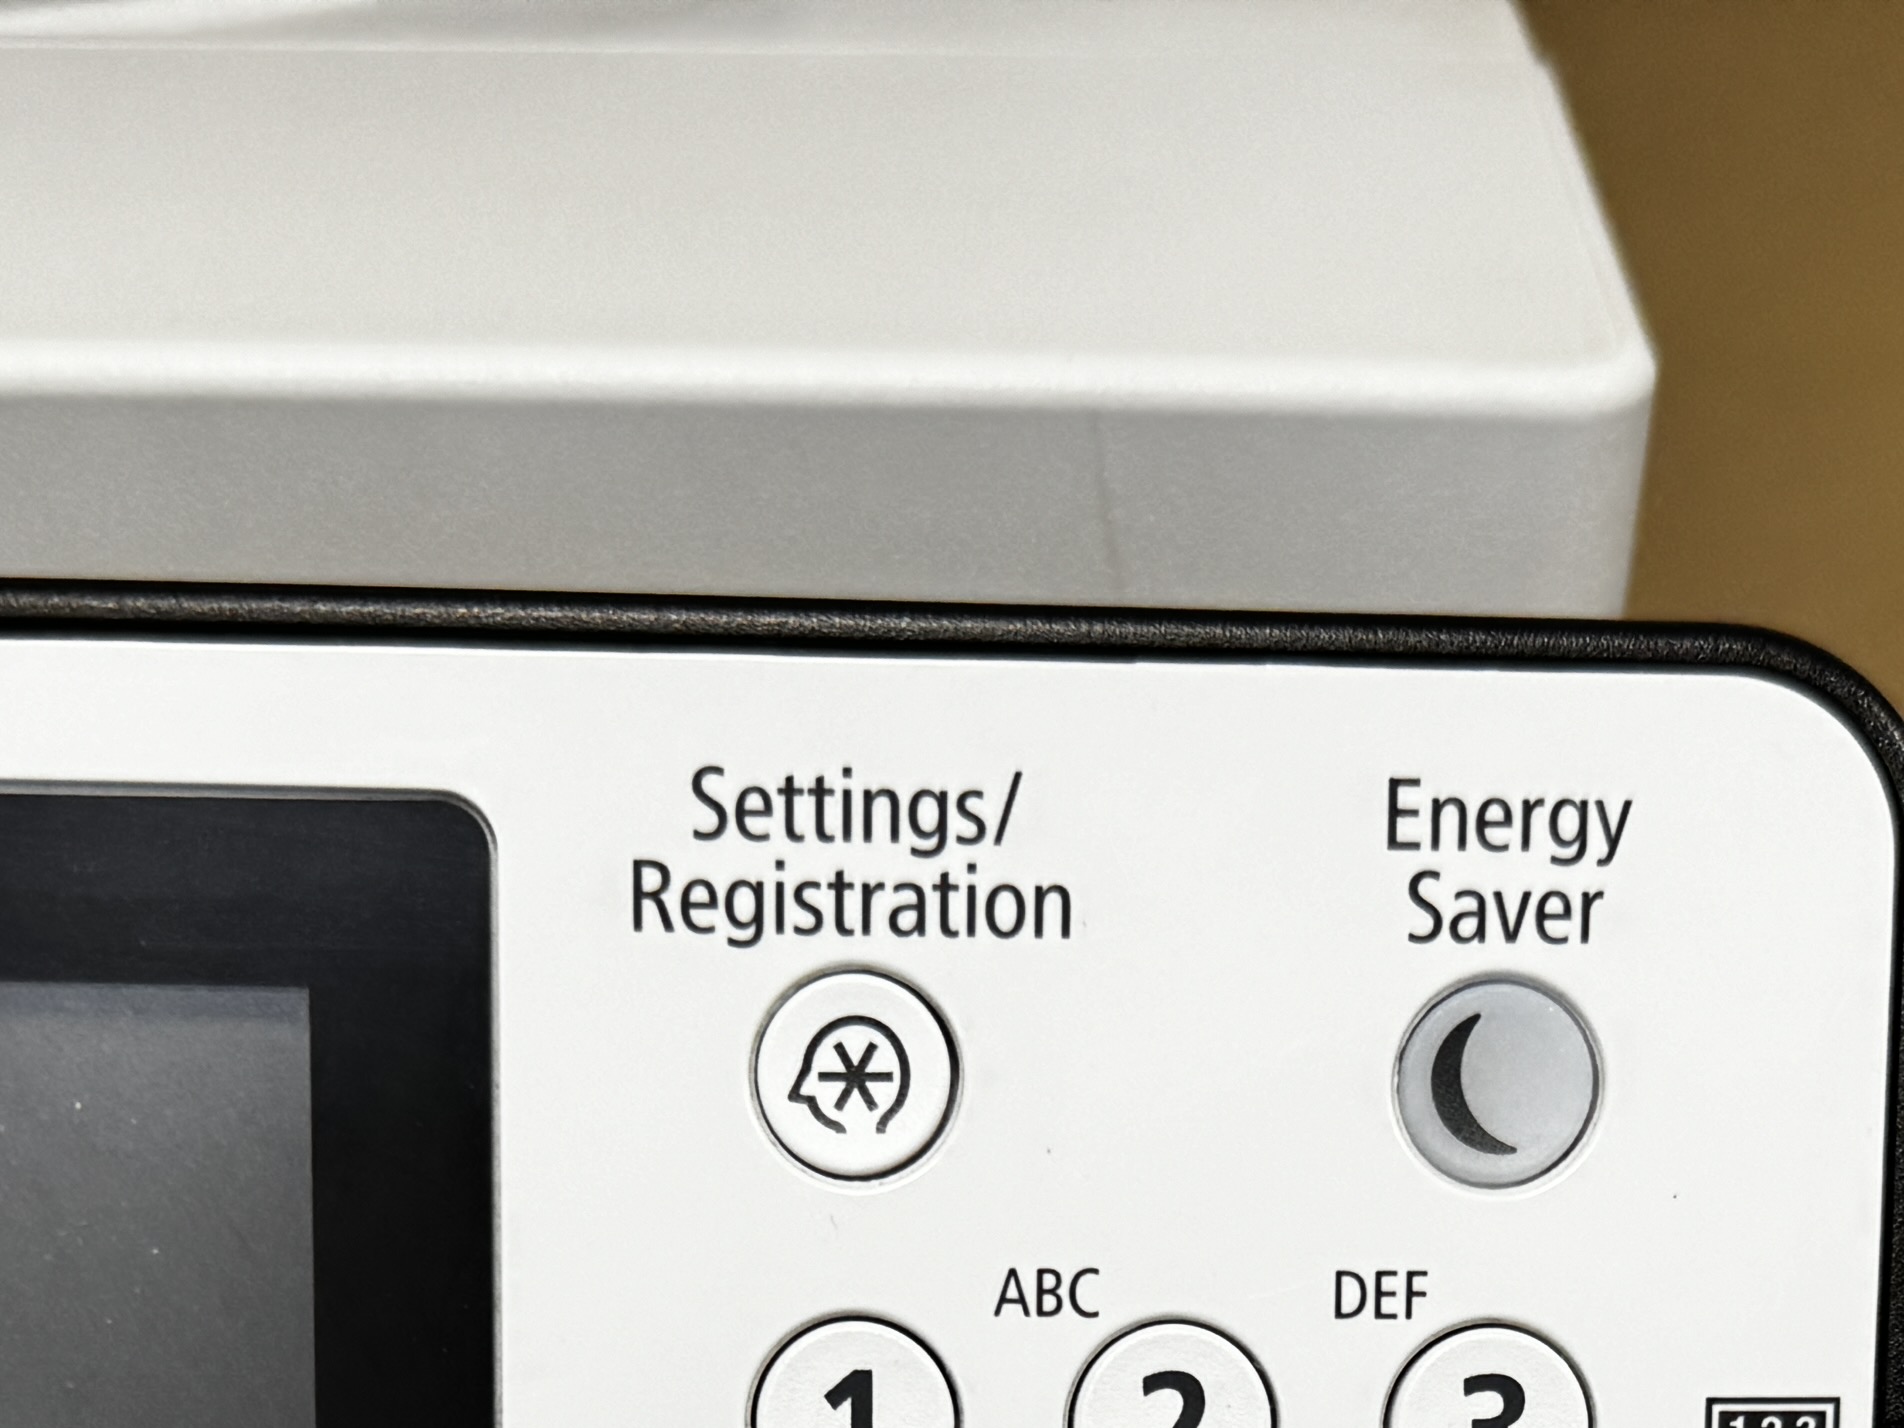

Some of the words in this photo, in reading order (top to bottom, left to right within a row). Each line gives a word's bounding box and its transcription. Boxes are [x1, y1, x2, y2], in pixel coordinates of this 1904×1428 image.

[690, 764, 1024, 856] Settings/
[1386, 776, 1634, 868] Energy
[631, 858, 1072, 950] Registration
[1407, 868, 1606, 946] Saver
[993, 1266, 1101, 1320] ABC
[1333, 1269, 1429, 1321] DEF
